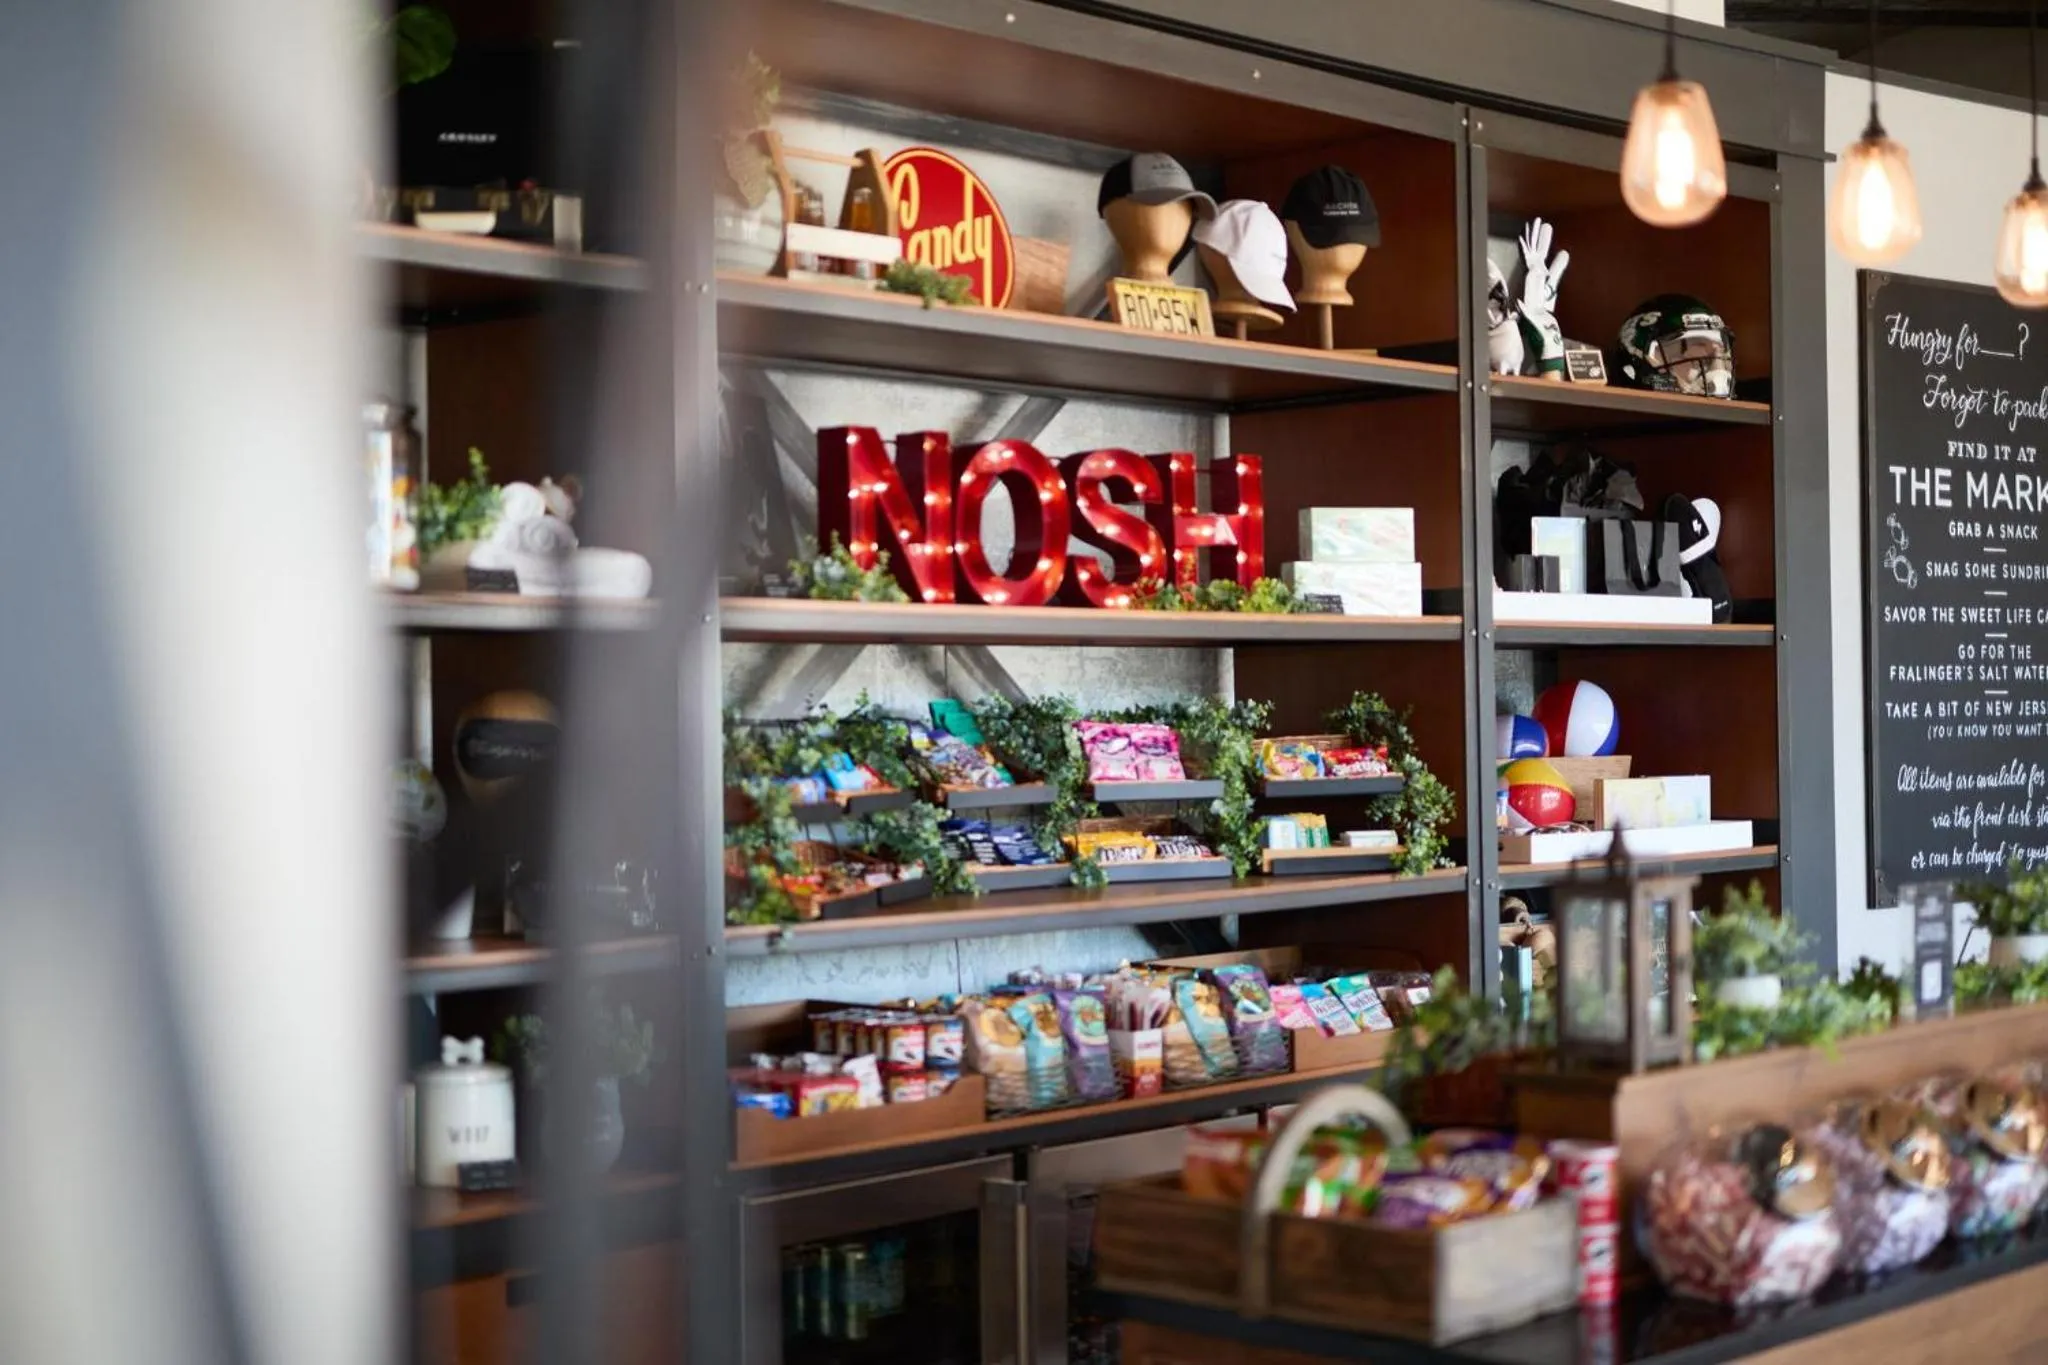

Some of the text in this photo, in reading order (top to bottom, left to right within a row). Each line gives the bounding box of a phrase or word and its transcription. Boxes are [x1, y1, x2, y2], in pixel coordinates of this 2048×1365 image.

[1885, 312, 1952, 365] Hungry
[1923, 374, 2048, 432] Forgot to pack
[1947, 440, 2036, 463] FIND IT AT
[1889, 465, 2048, 512] THE MARK
[817, 426, 1265, 604] NOSH
[1949, 521, 2038, 540] GRAB A SNACK
[1926, 561, 2048, 580] SNAG SOME SUNDRI
[1884, 606, 1926, 622] SAVOR
[1932, 606, 1954, 622] THE
[1961, 606, 2001, 623] SWEET
[2006, 608, 2031, 624] LIFE
[1958, 644, 2031, 659] GO FOR THE
[1890, 665, 1973, 682] FRALINGER'S
[1979, 665, 2008, 681] SALT
[1885, 700, 2048, 718] TAKE A BIT OF NEW JERS
[1957, 724, 1988, 738] KNOW
[1992, 724, 2012, 736] YOU
[2015, 723, 2042, 736] WANT
[1897, 758, 2045, 798] All items are available for
[1932, 811, 1950, 828] via
[1954, 805, 1972, 828] the
[1973, 801, 2005, 839] front
[2007, 800, 2031, 827] desk
[1911, 850, 1925, 869] or
[1928, 852, 1949, 867] can
[1952, 846, 1964, 866] be
[1966, 841, 2006, 874] charged
